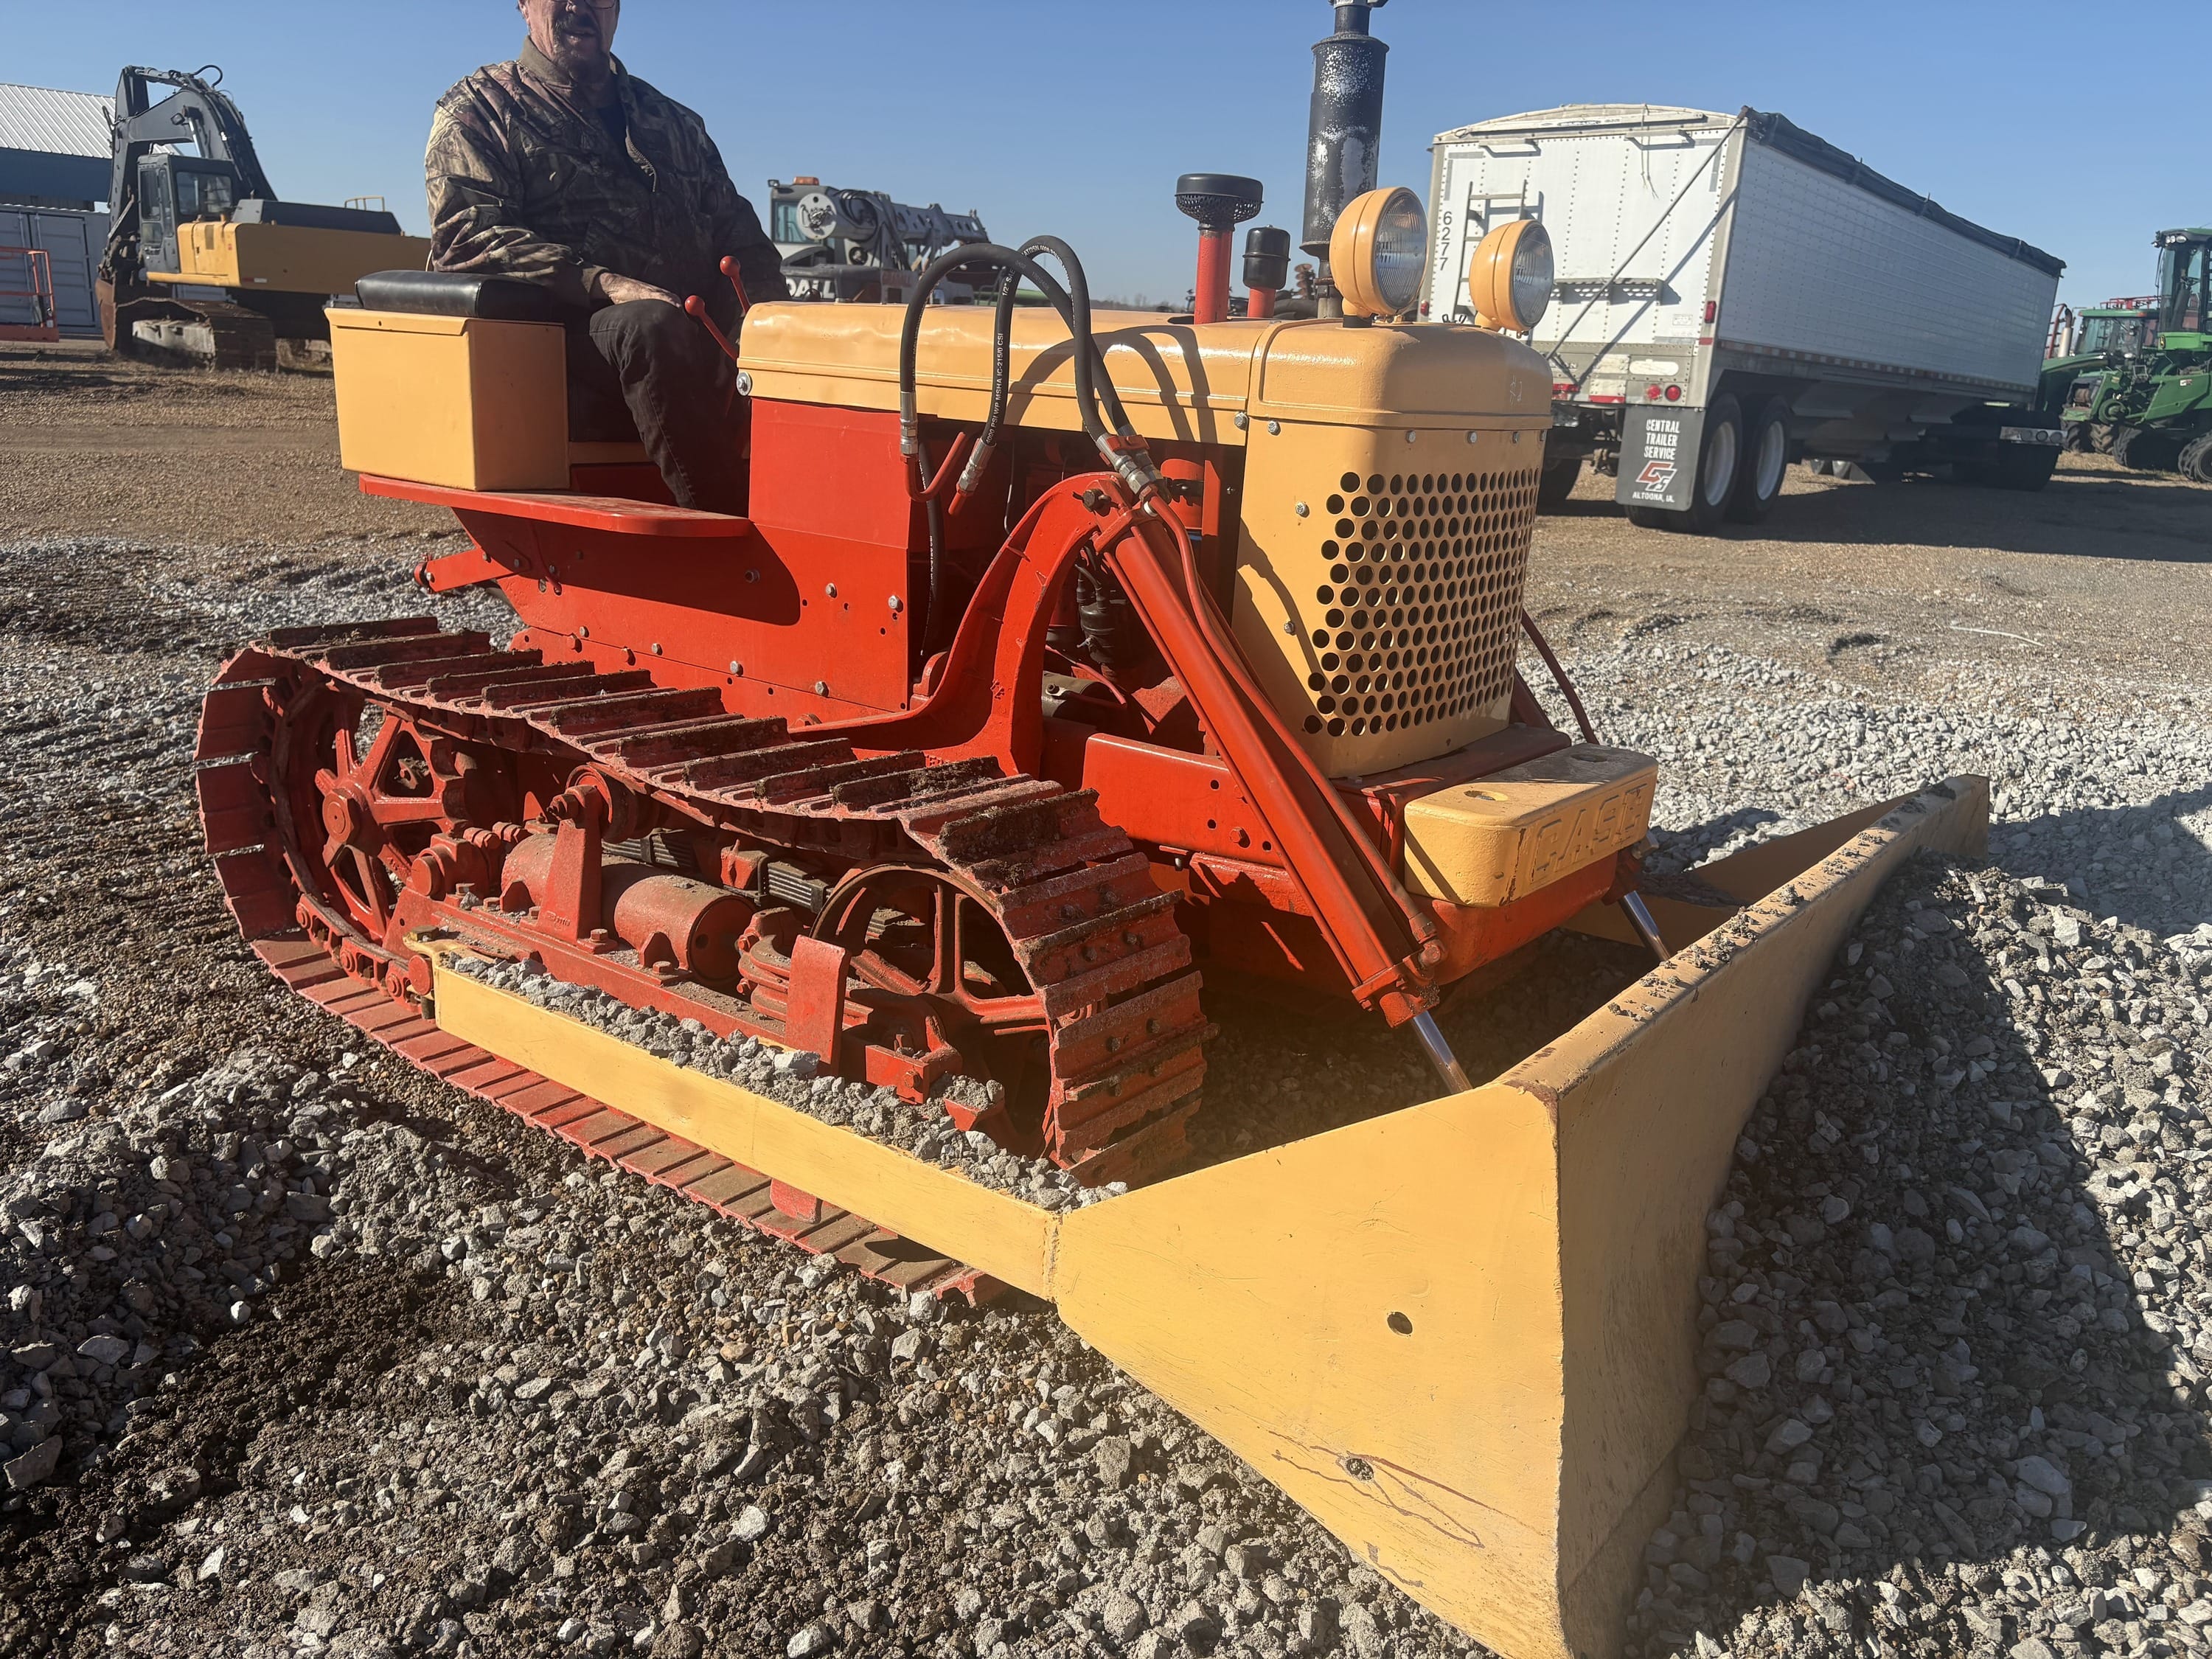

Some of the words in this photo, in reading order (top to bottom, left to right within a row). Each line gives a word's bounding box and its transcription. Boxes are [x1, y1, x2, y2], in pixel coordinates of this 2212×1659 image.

[1439, 211, 1453, 271] 6277
[985, 428, 995, 444] 4000
[993, 402, 1001, 414] WP
[1646, 419, 1680, 434] CENTRAL
[1644, 445, 1677, 460] SERVICE
[1646, 432, 1677, 447] TRAILER
[1530, 783, 1648, 882] CASE
